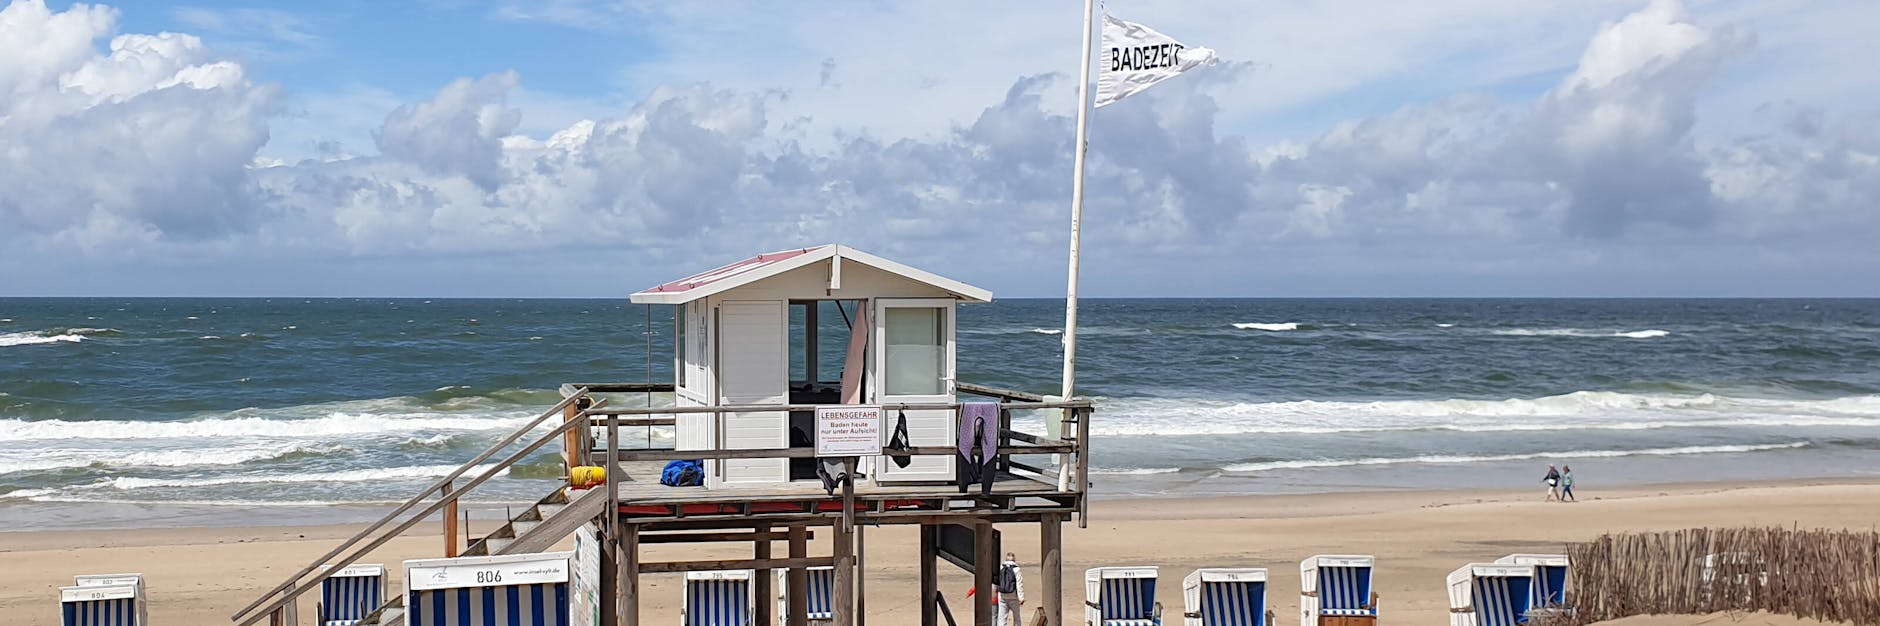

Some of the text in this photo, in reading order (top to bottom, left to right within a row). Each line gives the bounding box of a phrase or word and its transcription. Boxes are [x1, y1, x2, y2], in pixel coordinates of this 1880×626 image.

[1111, 43, 1184, 71] BADEZEIT
[821, 411, 878, 419] LEBENSGEFAHR
[477, 570, 502, 583] 806
